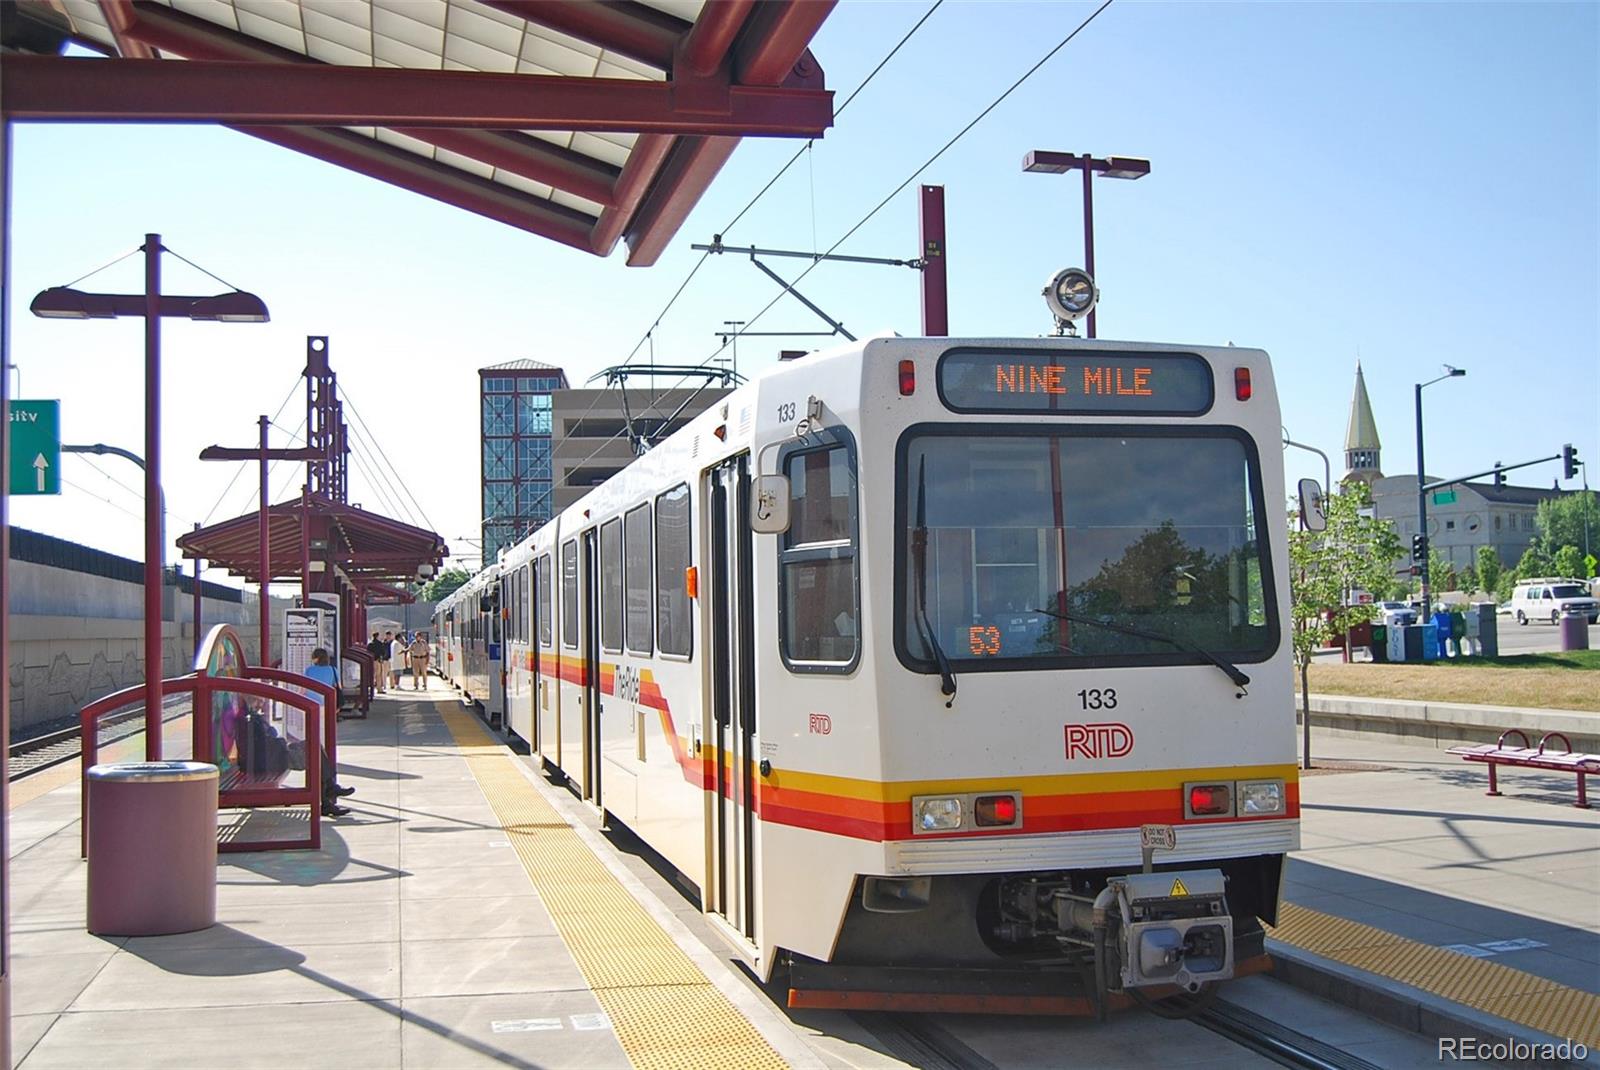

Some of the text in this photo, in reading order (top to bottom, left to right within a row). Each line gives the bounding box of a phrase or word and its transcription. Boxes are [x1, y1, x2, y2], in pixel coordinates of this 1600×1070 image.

[995, 364, 1153, 397] NINE MILE
[777, 402, 796, 424] 133
[969, 625, 1002, 656] 53
[1077, 688, 1118, 710] 133
[809, 713, 832, 735] RTD
[1064, 722, 1134, 760] RTD
